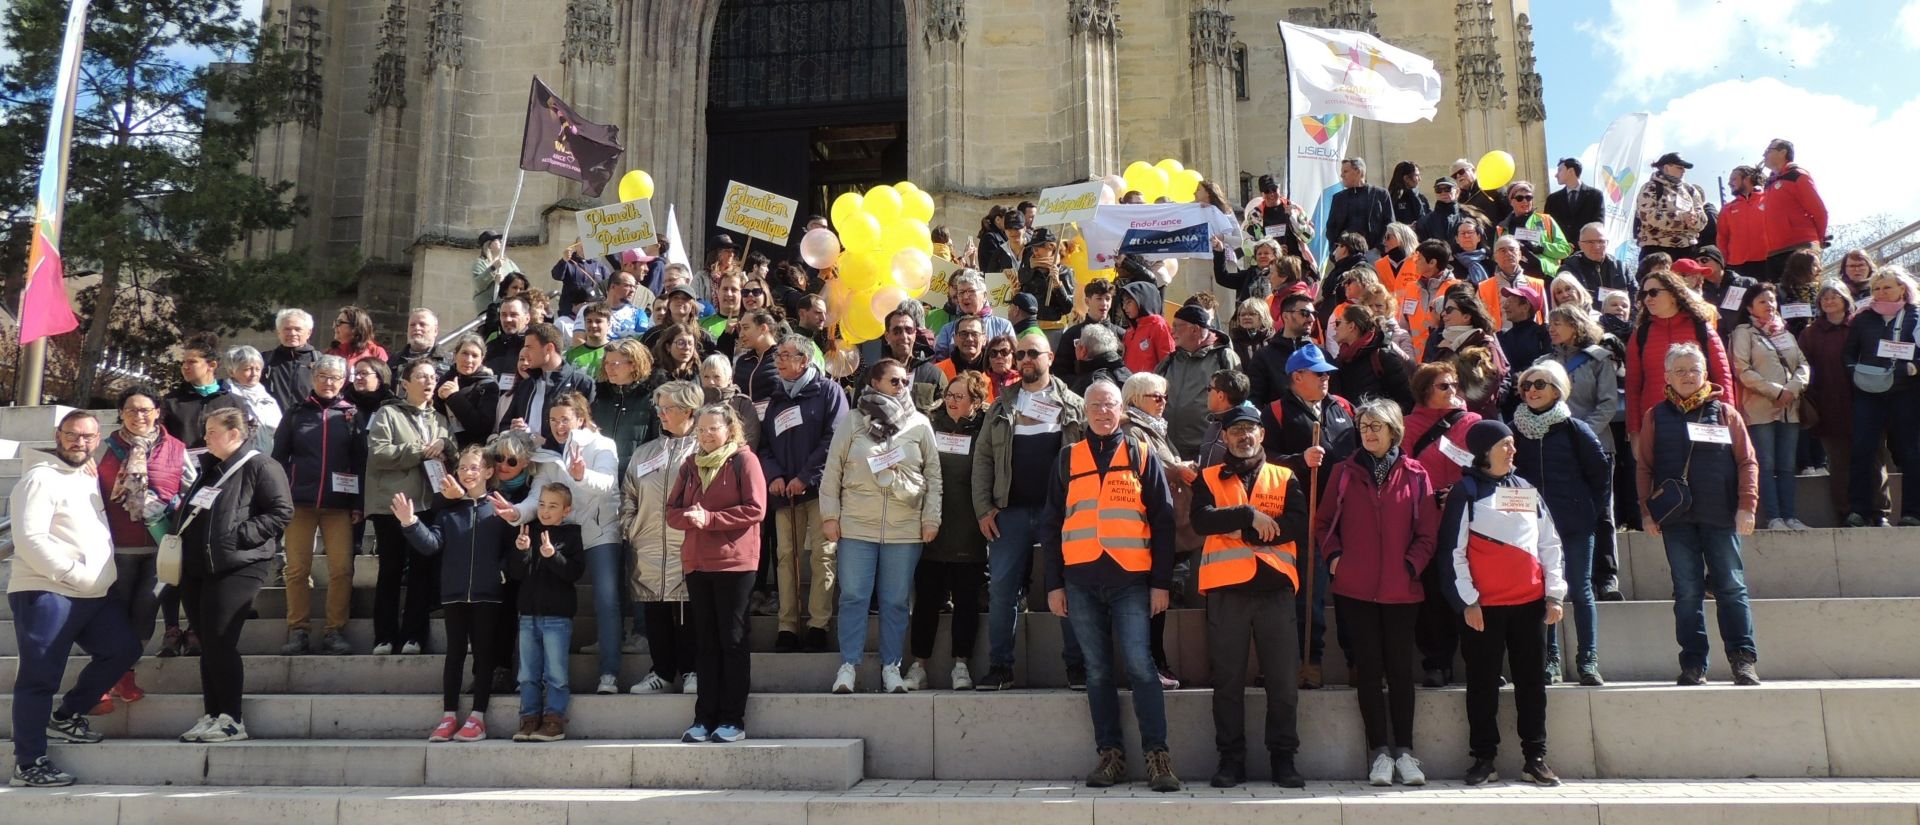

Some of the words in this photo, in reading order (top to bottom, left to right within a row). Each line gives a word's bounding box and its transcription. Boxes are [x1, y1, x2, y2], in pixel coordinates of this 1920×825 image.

[1297, 145, 1339, 158] LISIEUX
[1130, 218, 1182, 228] EndoFrance
[596, 223, 654, 256] Patient
[1128, 234, 1199, 245] #LiveUSANA
[1110, 495, 1136, 503] LISIEUX
[1255, 493, 1284, 502] RETRAIT
[1260, 502, 1285, 511] ACTIVE
